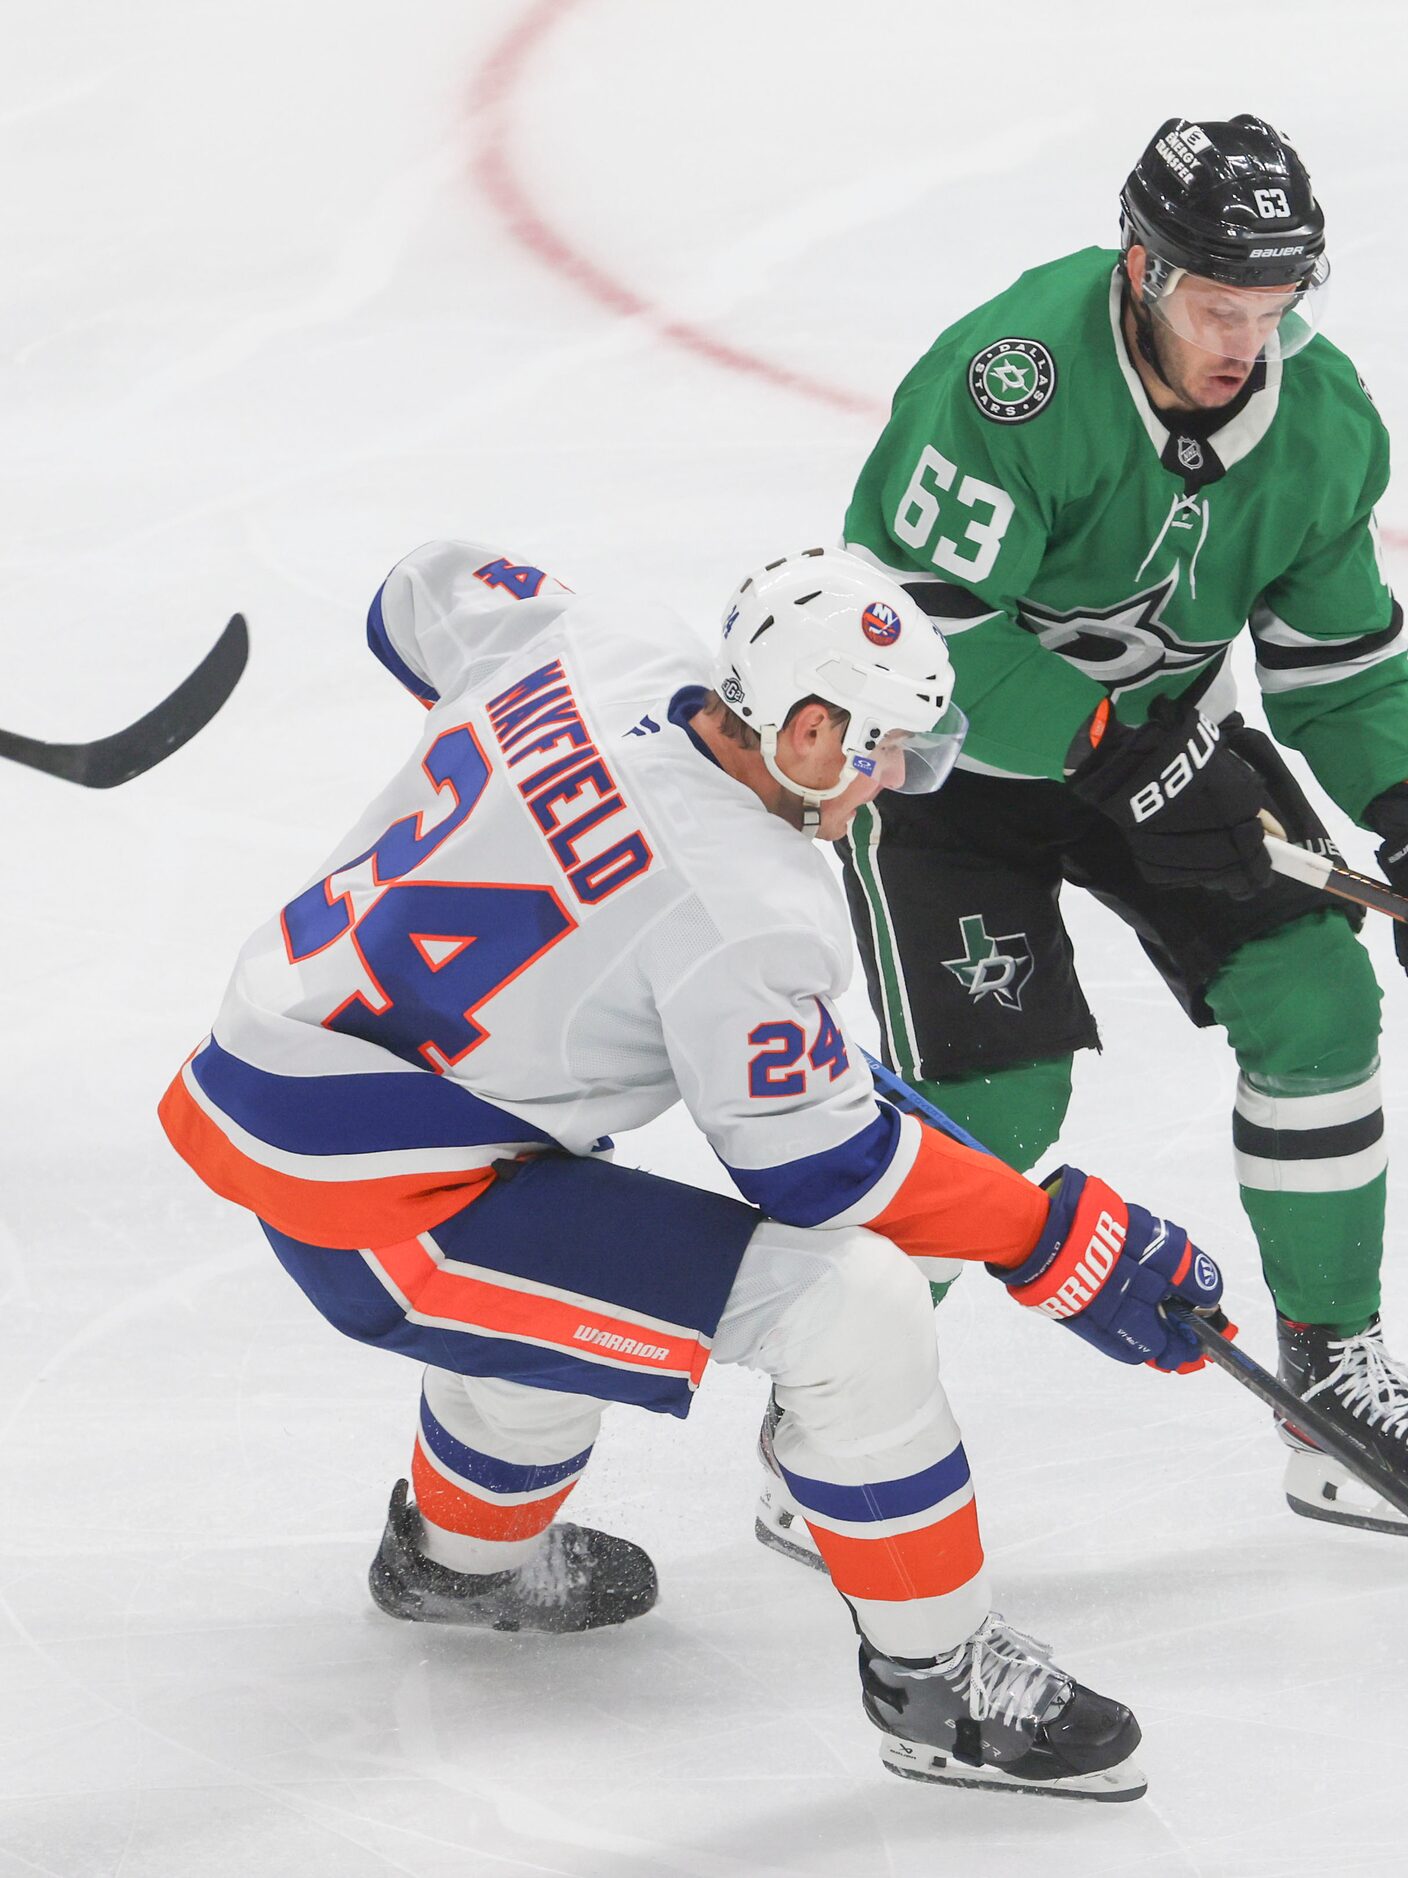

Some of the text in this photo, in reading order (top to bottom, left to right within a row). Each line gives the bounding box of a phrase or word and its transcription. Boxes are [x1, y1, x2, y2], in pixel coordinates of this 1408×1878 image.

[1154, 138, 1195, 185] TRANSFER
[1165, 131, 1202, 169] ENERGY
[1253, 188, 1291, 219] 63
[973, 362, 1016, 416] STARS
[999, 343, 1049, 402] DALLAS
[894, 444, 1016, 584] 63
[472, 557, 547, 600] 4
[486, 657, 654, 906] MAYFIELD
[281, 720, 580, 1077] 24
[747, 995, 850, 1099] 24
[1045, 1210, 1127, 1320] RRIOR
[572, 1324, 670, 1362] WARRIOR
